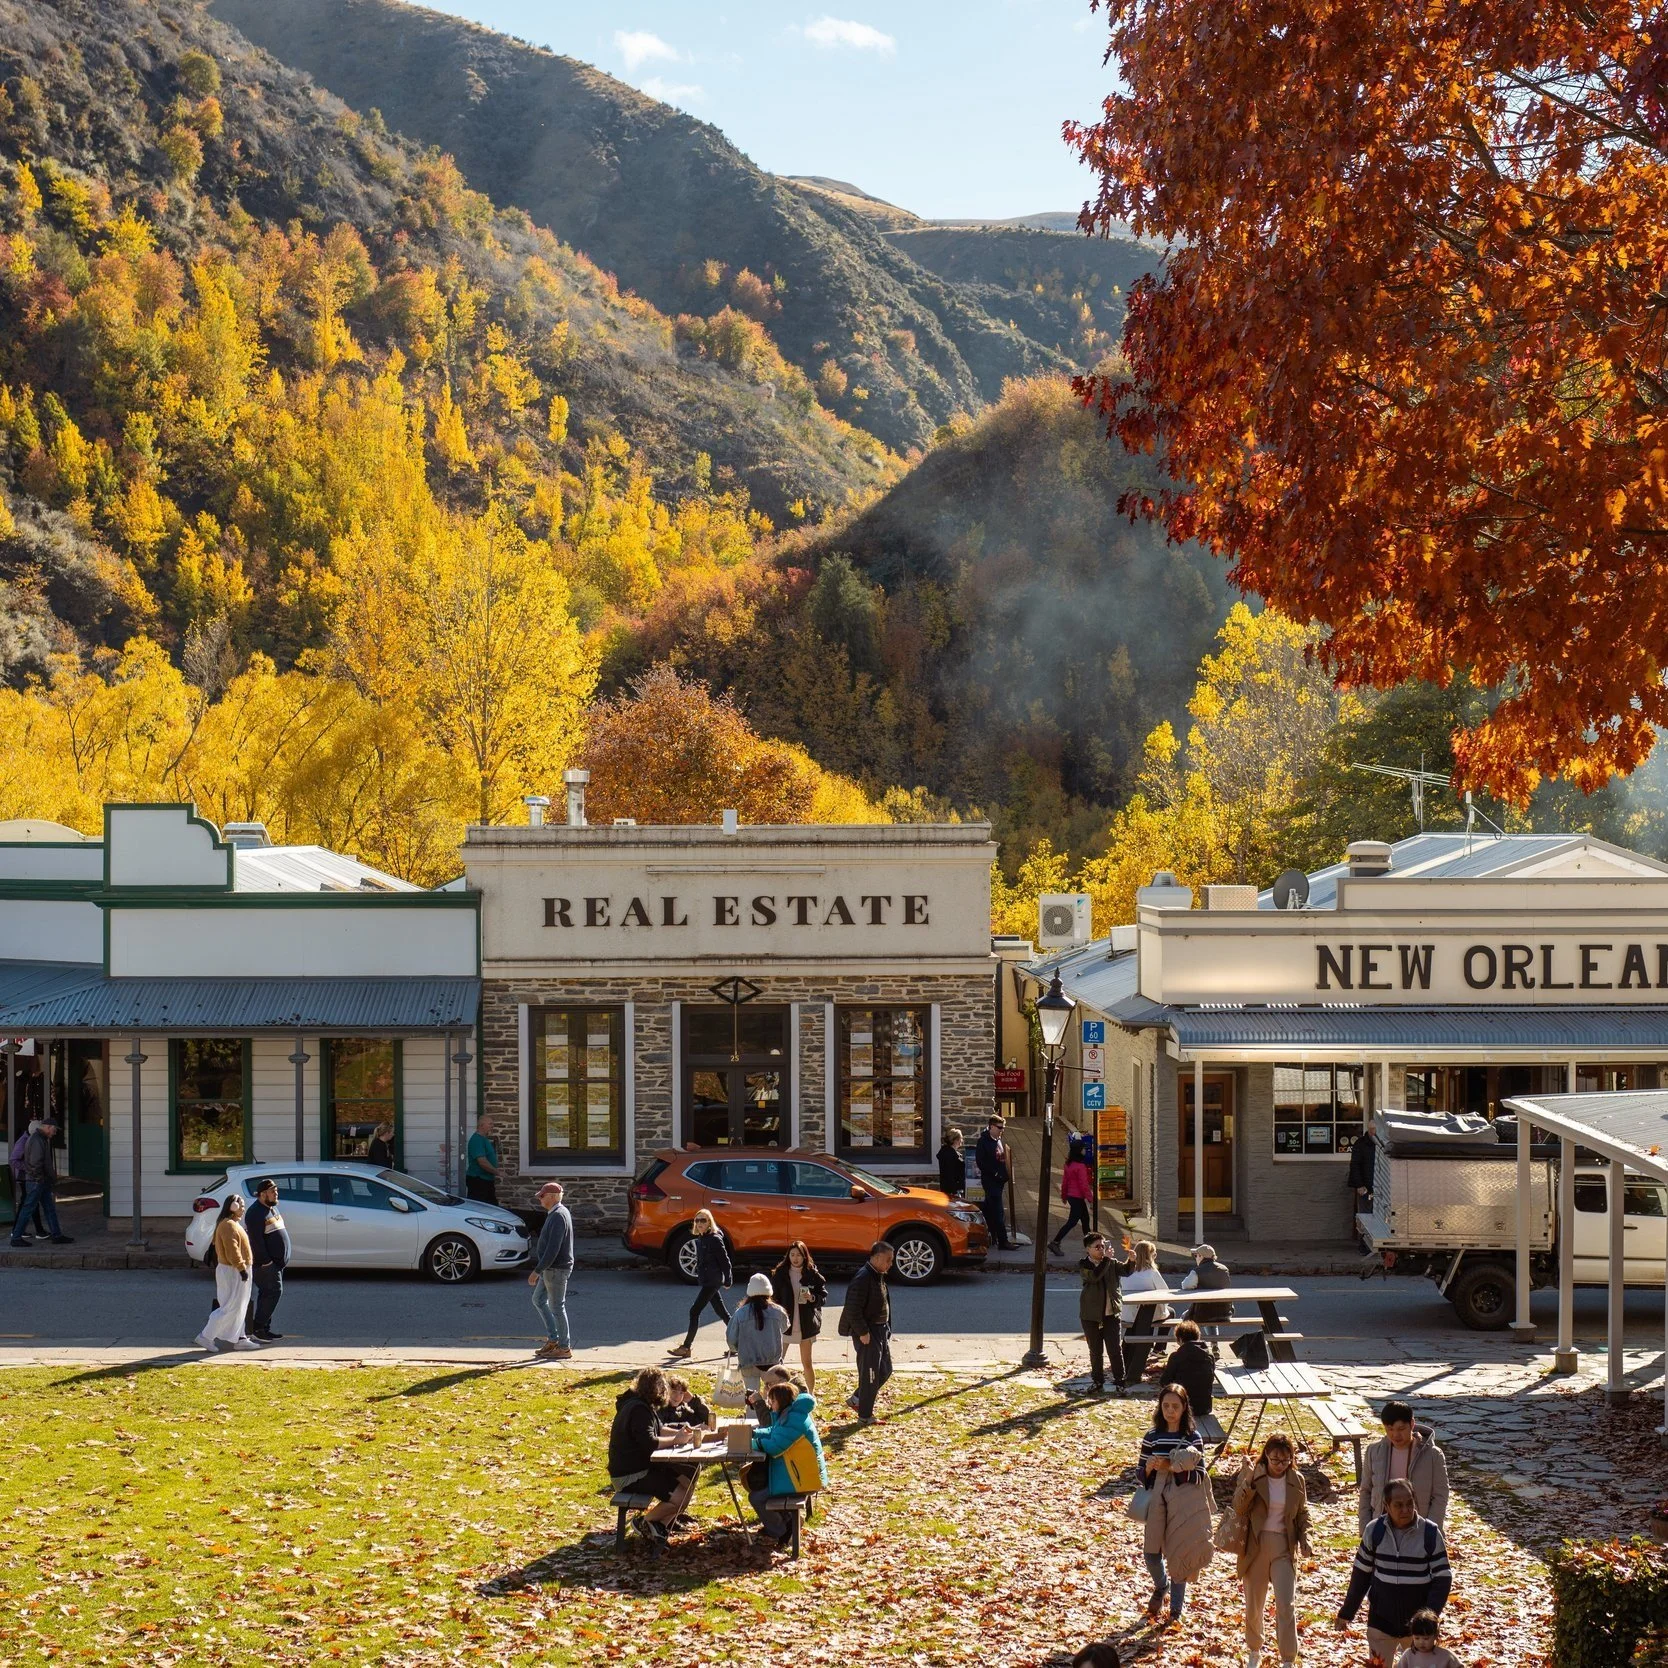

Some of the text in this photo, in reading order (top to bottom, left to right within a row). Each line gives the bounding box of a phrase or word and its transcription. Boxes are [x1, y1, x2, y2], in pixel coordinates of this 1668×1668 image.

[541, 895, 930, 928] REAL ESTATE
[1315, 944, 1436, 990] NEW
[1090, 1022, 1098, 1031] P
[1089, 1031, 1099, 1040] 60
[1086, 1099, 1102, 1107] CCTV
